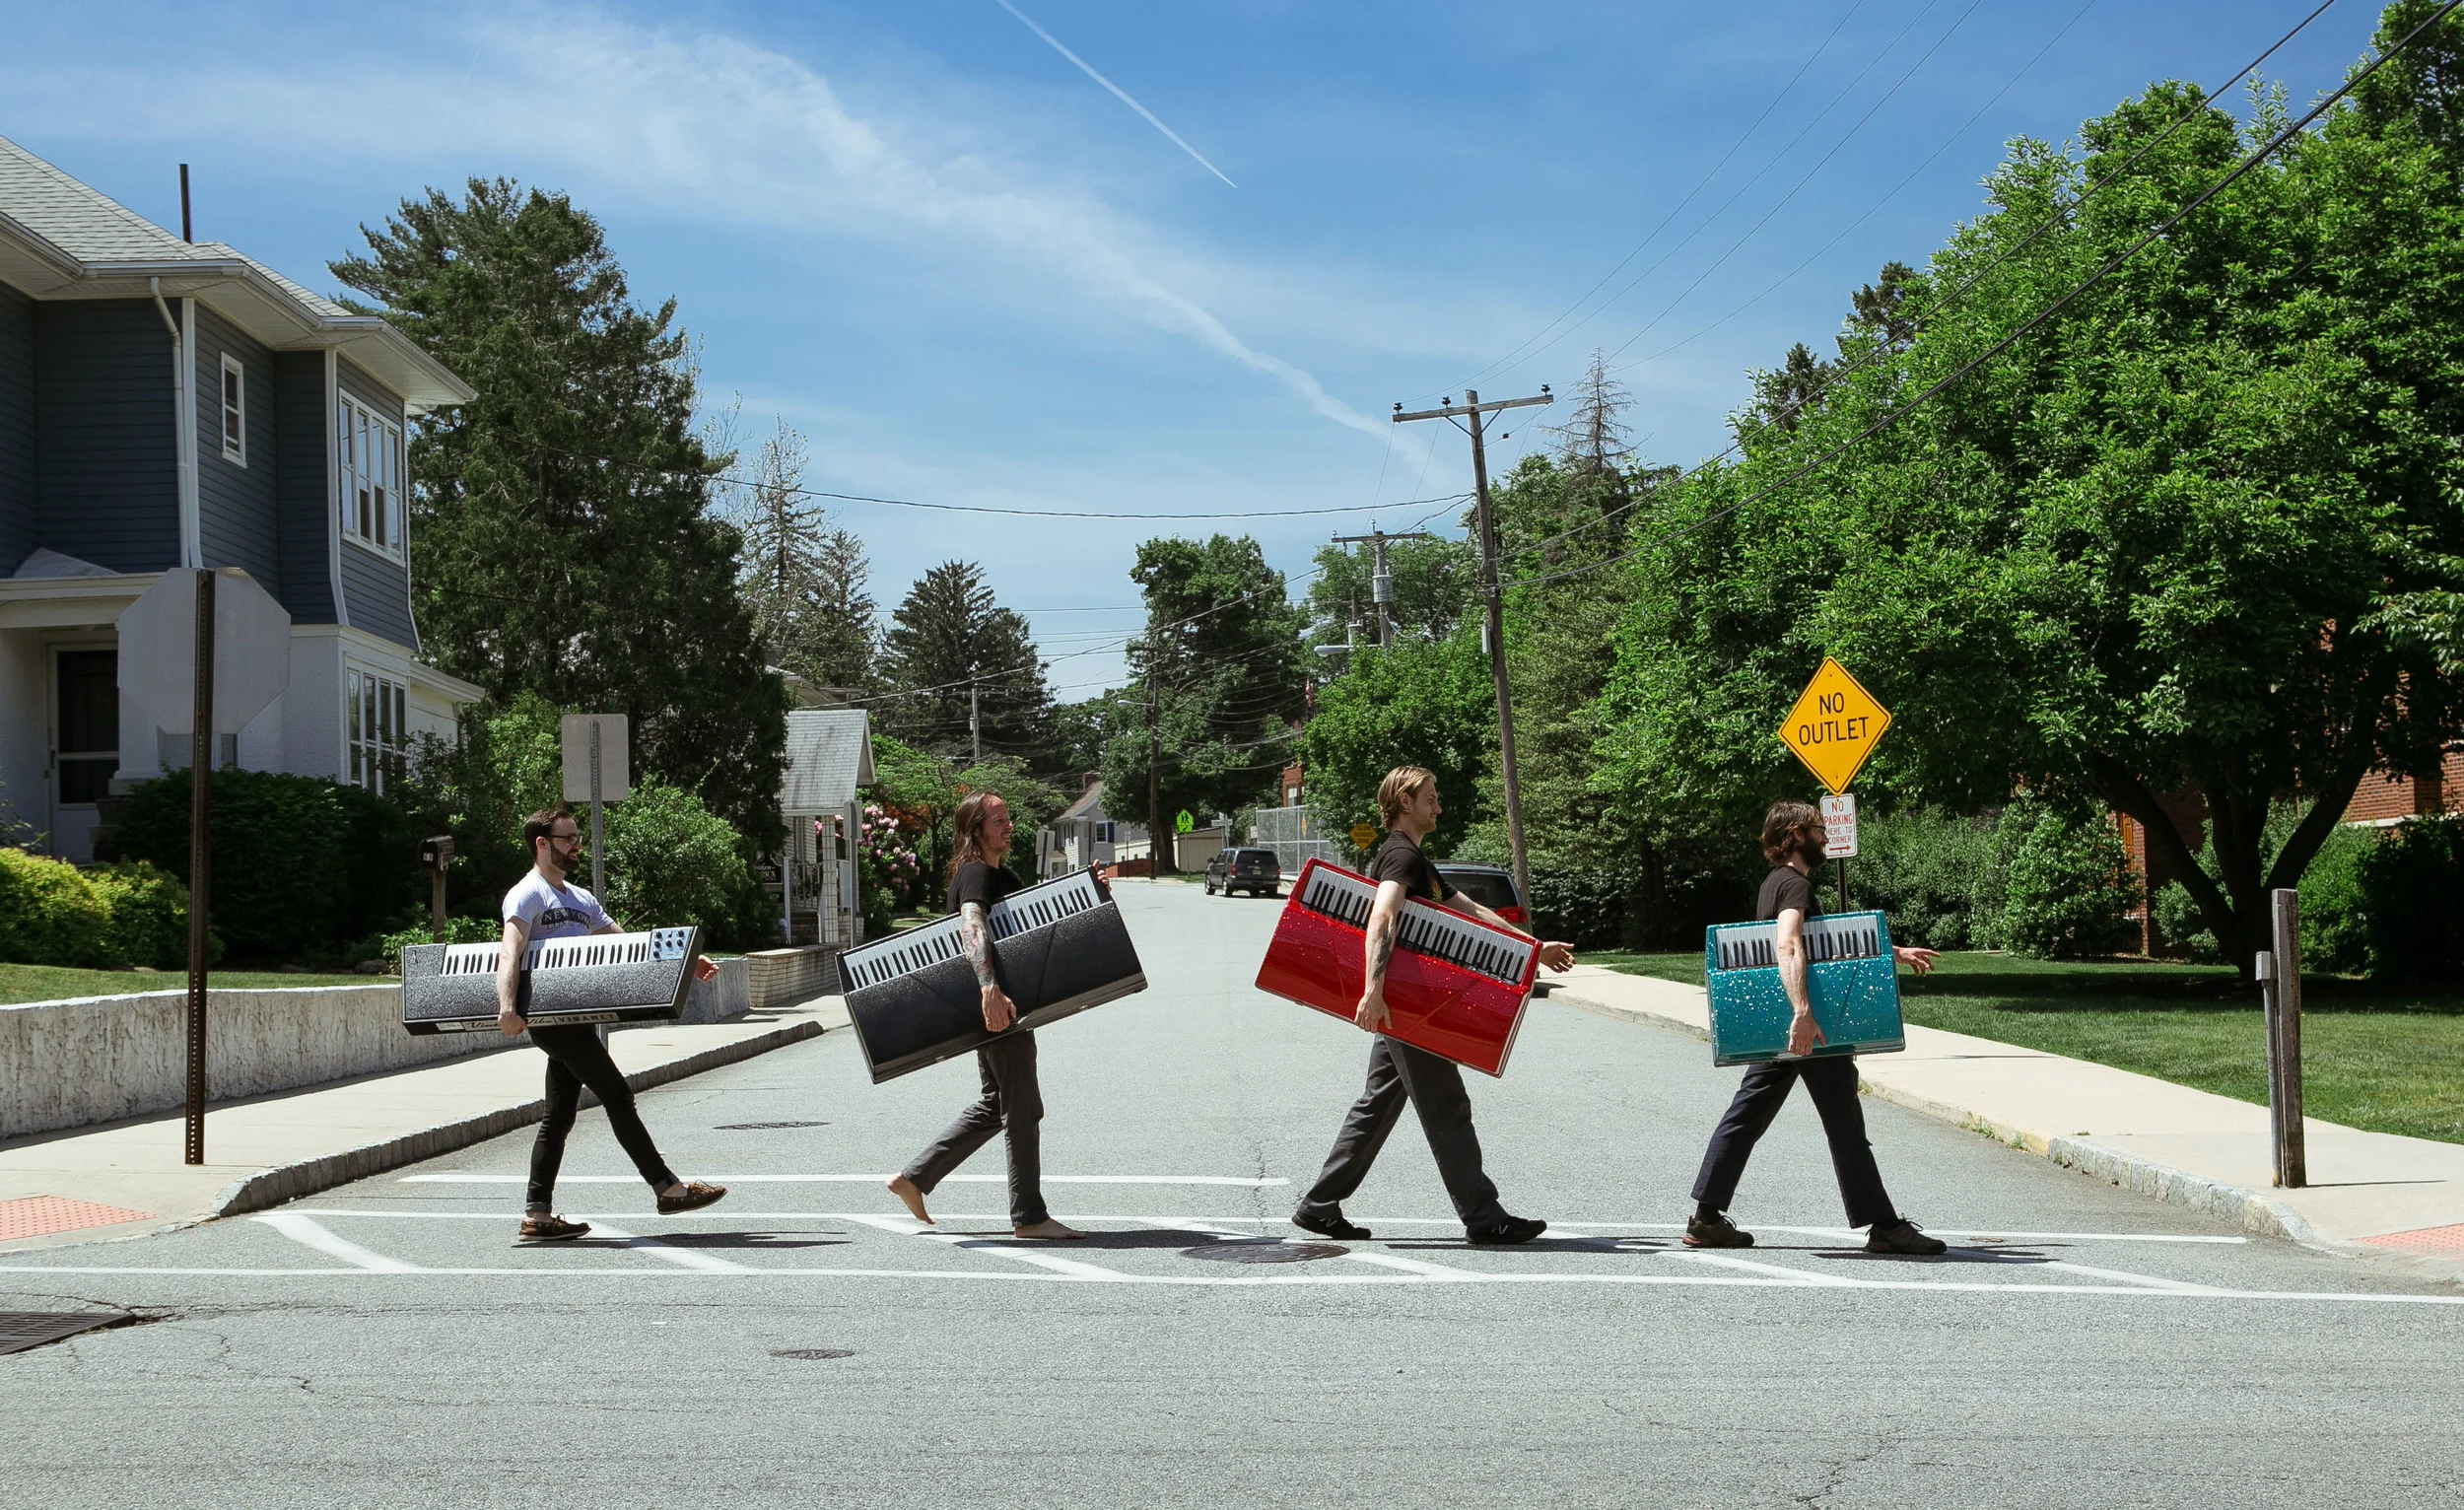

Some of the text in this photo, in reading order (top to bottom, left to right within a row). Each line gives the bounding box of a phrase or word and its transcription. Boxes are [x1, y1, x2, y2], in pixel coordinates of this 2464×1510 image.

[1818, 692, 1845, 716] NO
[1799, 717, 1870, 746] OUTLET
[1831, 800, 1844, 813] NO
[1823, 813, 1853, 827] PARKING
[1829, 835, 1852, 846] CORNER
[544, 909, 569, 922] NEW
[558, 1013, 615, 1024] VIBANET
